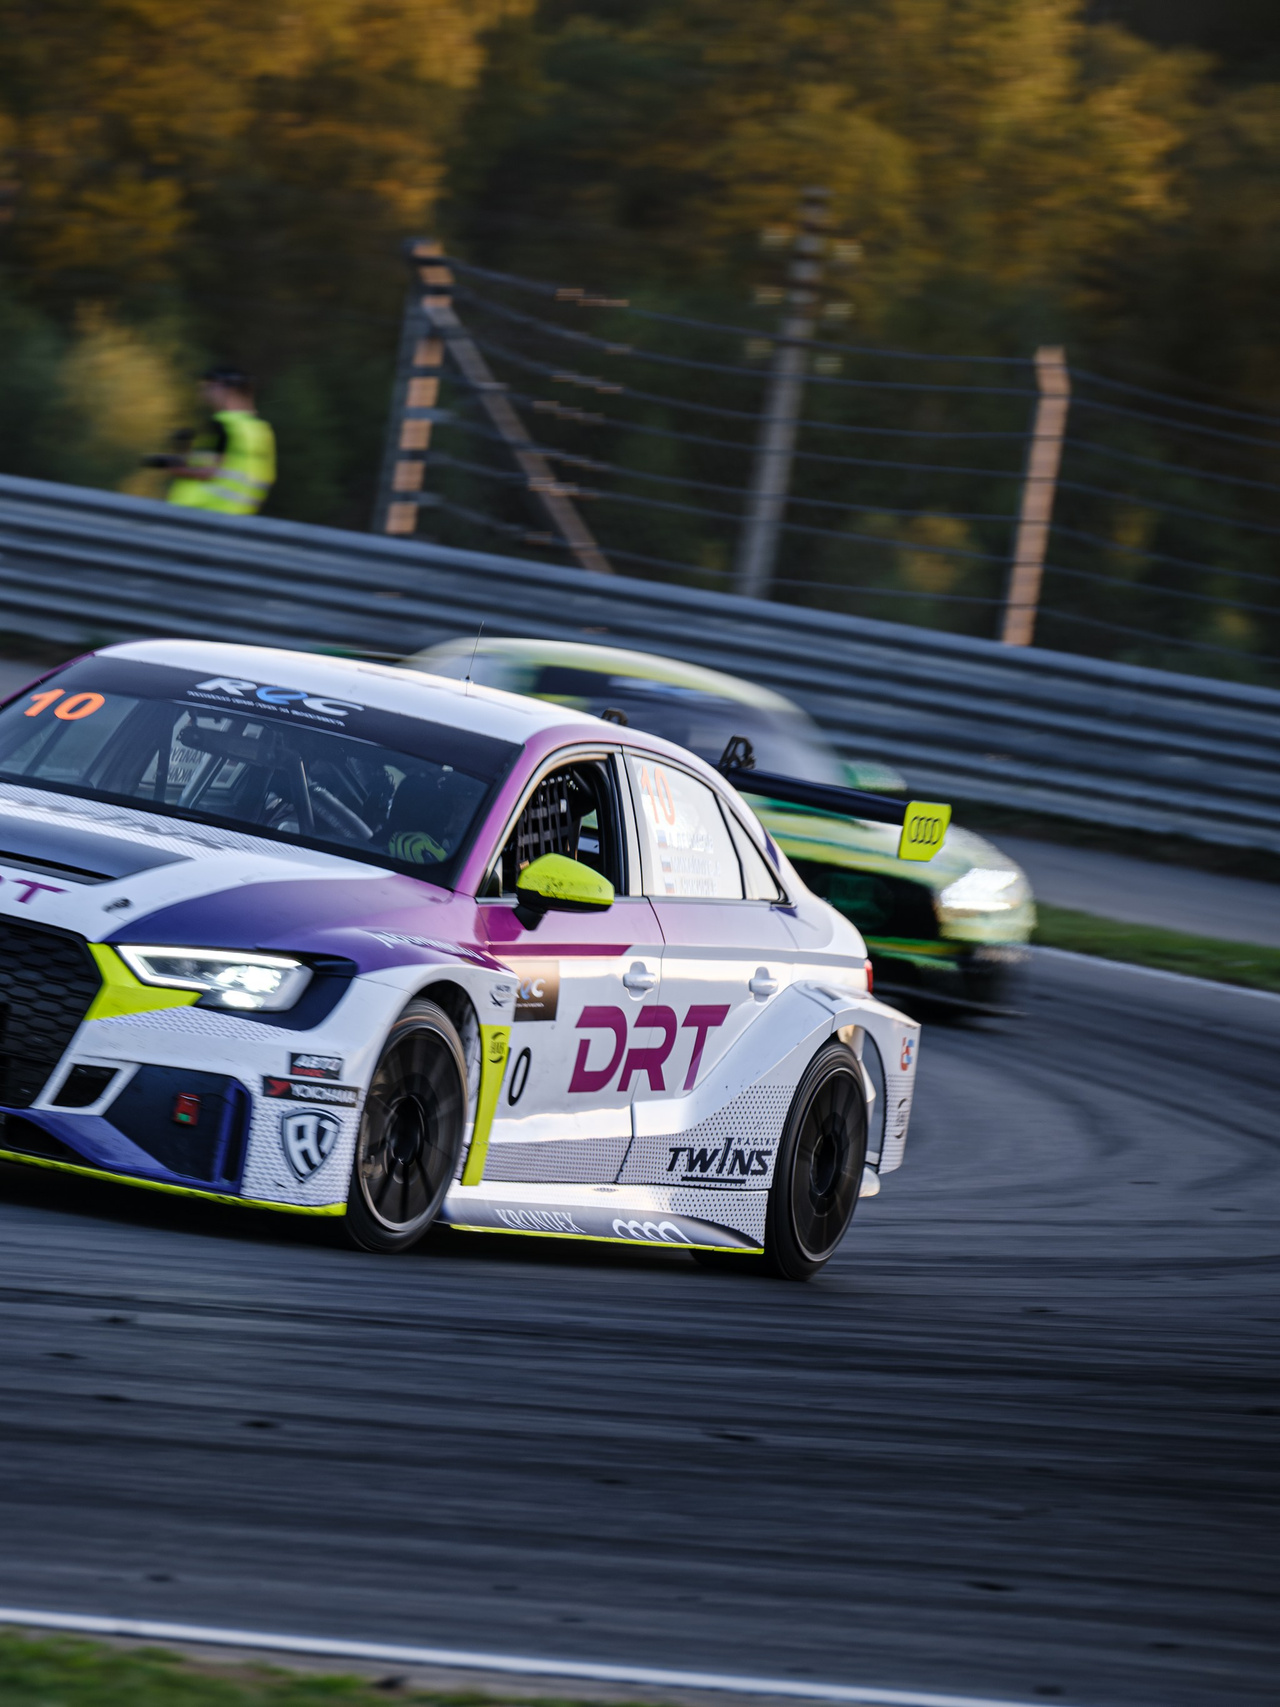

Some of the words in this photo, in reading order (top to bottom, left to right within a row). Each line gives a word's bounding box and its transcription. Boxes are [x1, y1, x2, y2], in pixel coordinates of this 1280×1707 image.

[23, 688, 106, 721] 10
[640, 765, 676, 826] 10
[567, 1003, 731, 1093] DRT
[666, 1137, 773, 1176] TWINS
